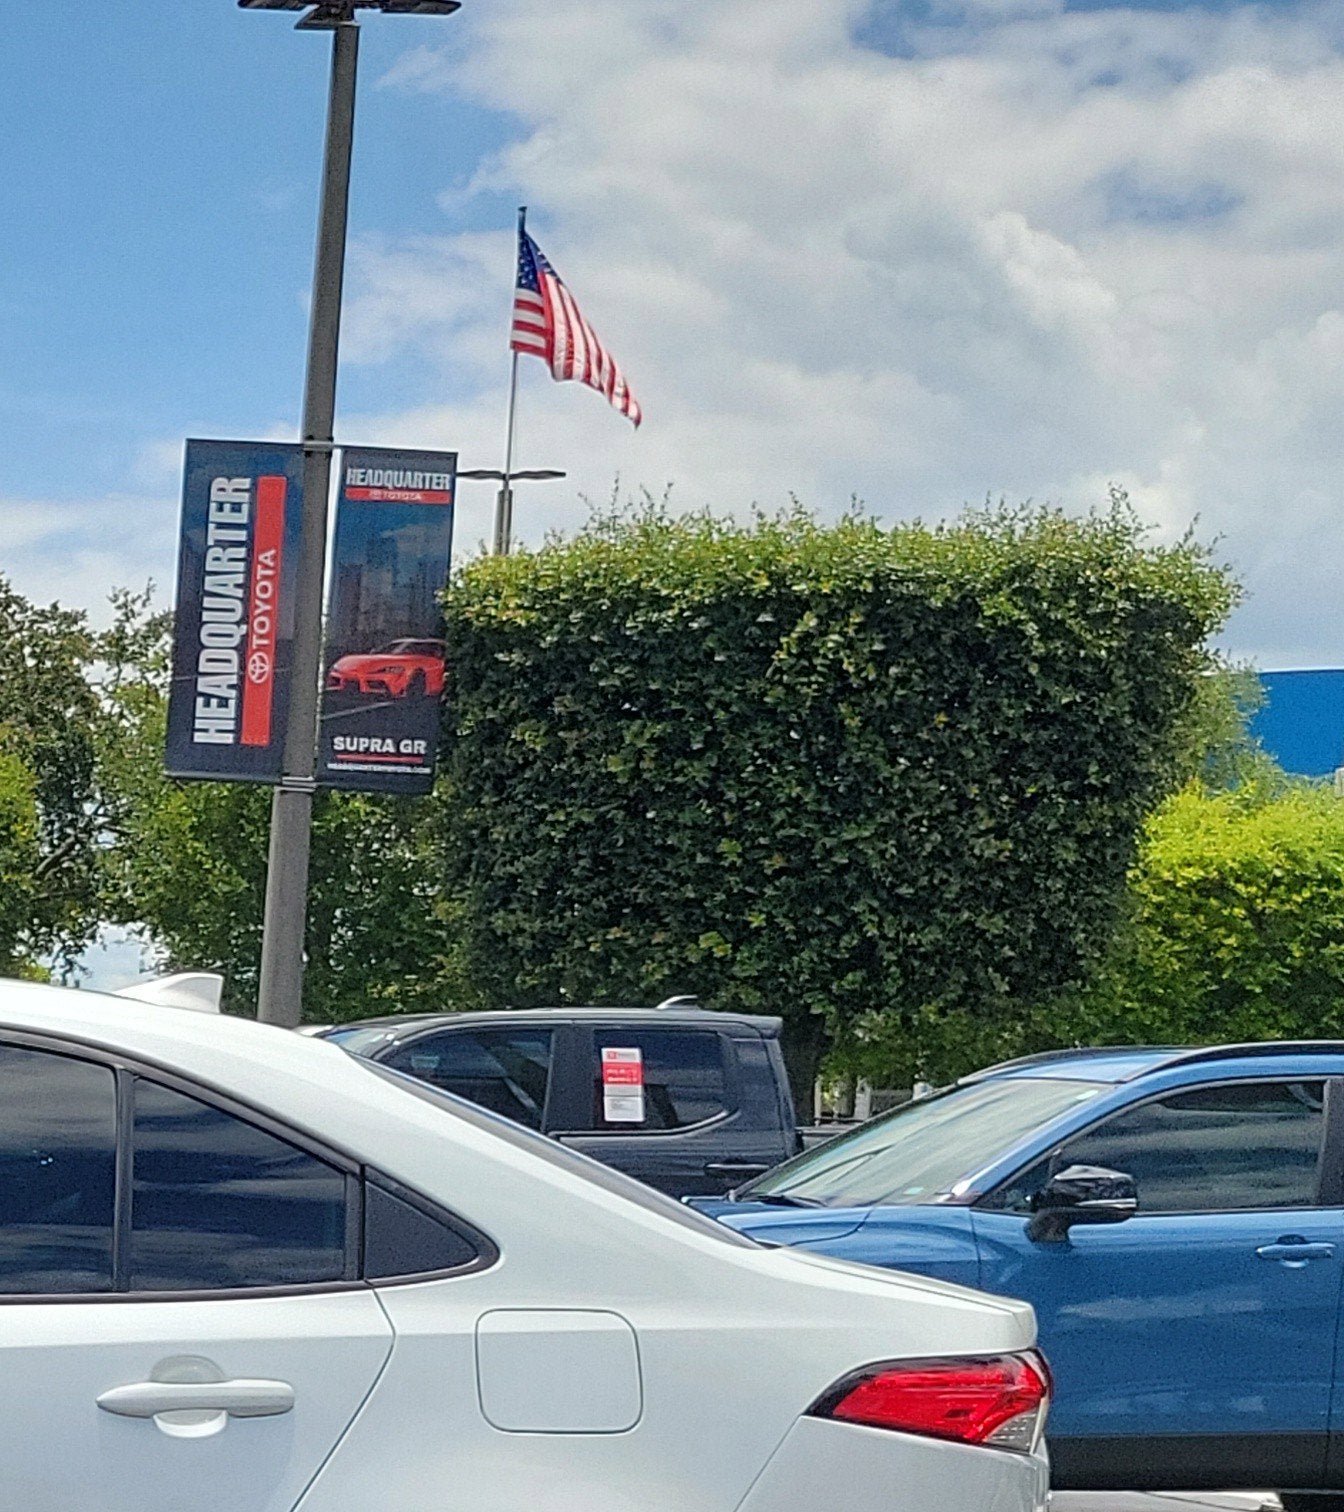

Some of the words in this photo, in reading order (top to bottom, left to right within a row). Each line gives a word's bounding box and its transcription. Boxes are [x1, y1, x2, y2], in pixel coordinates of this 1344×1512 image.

[346, 467, 450, 490] HEADQUARTER
[193, 476, 252, 744] HEADQUARTER
[252, 549, 276, 650] TOYOTA
[333, 736, 396, 753] SUPRA
[399, 739, 427, 754] GR
